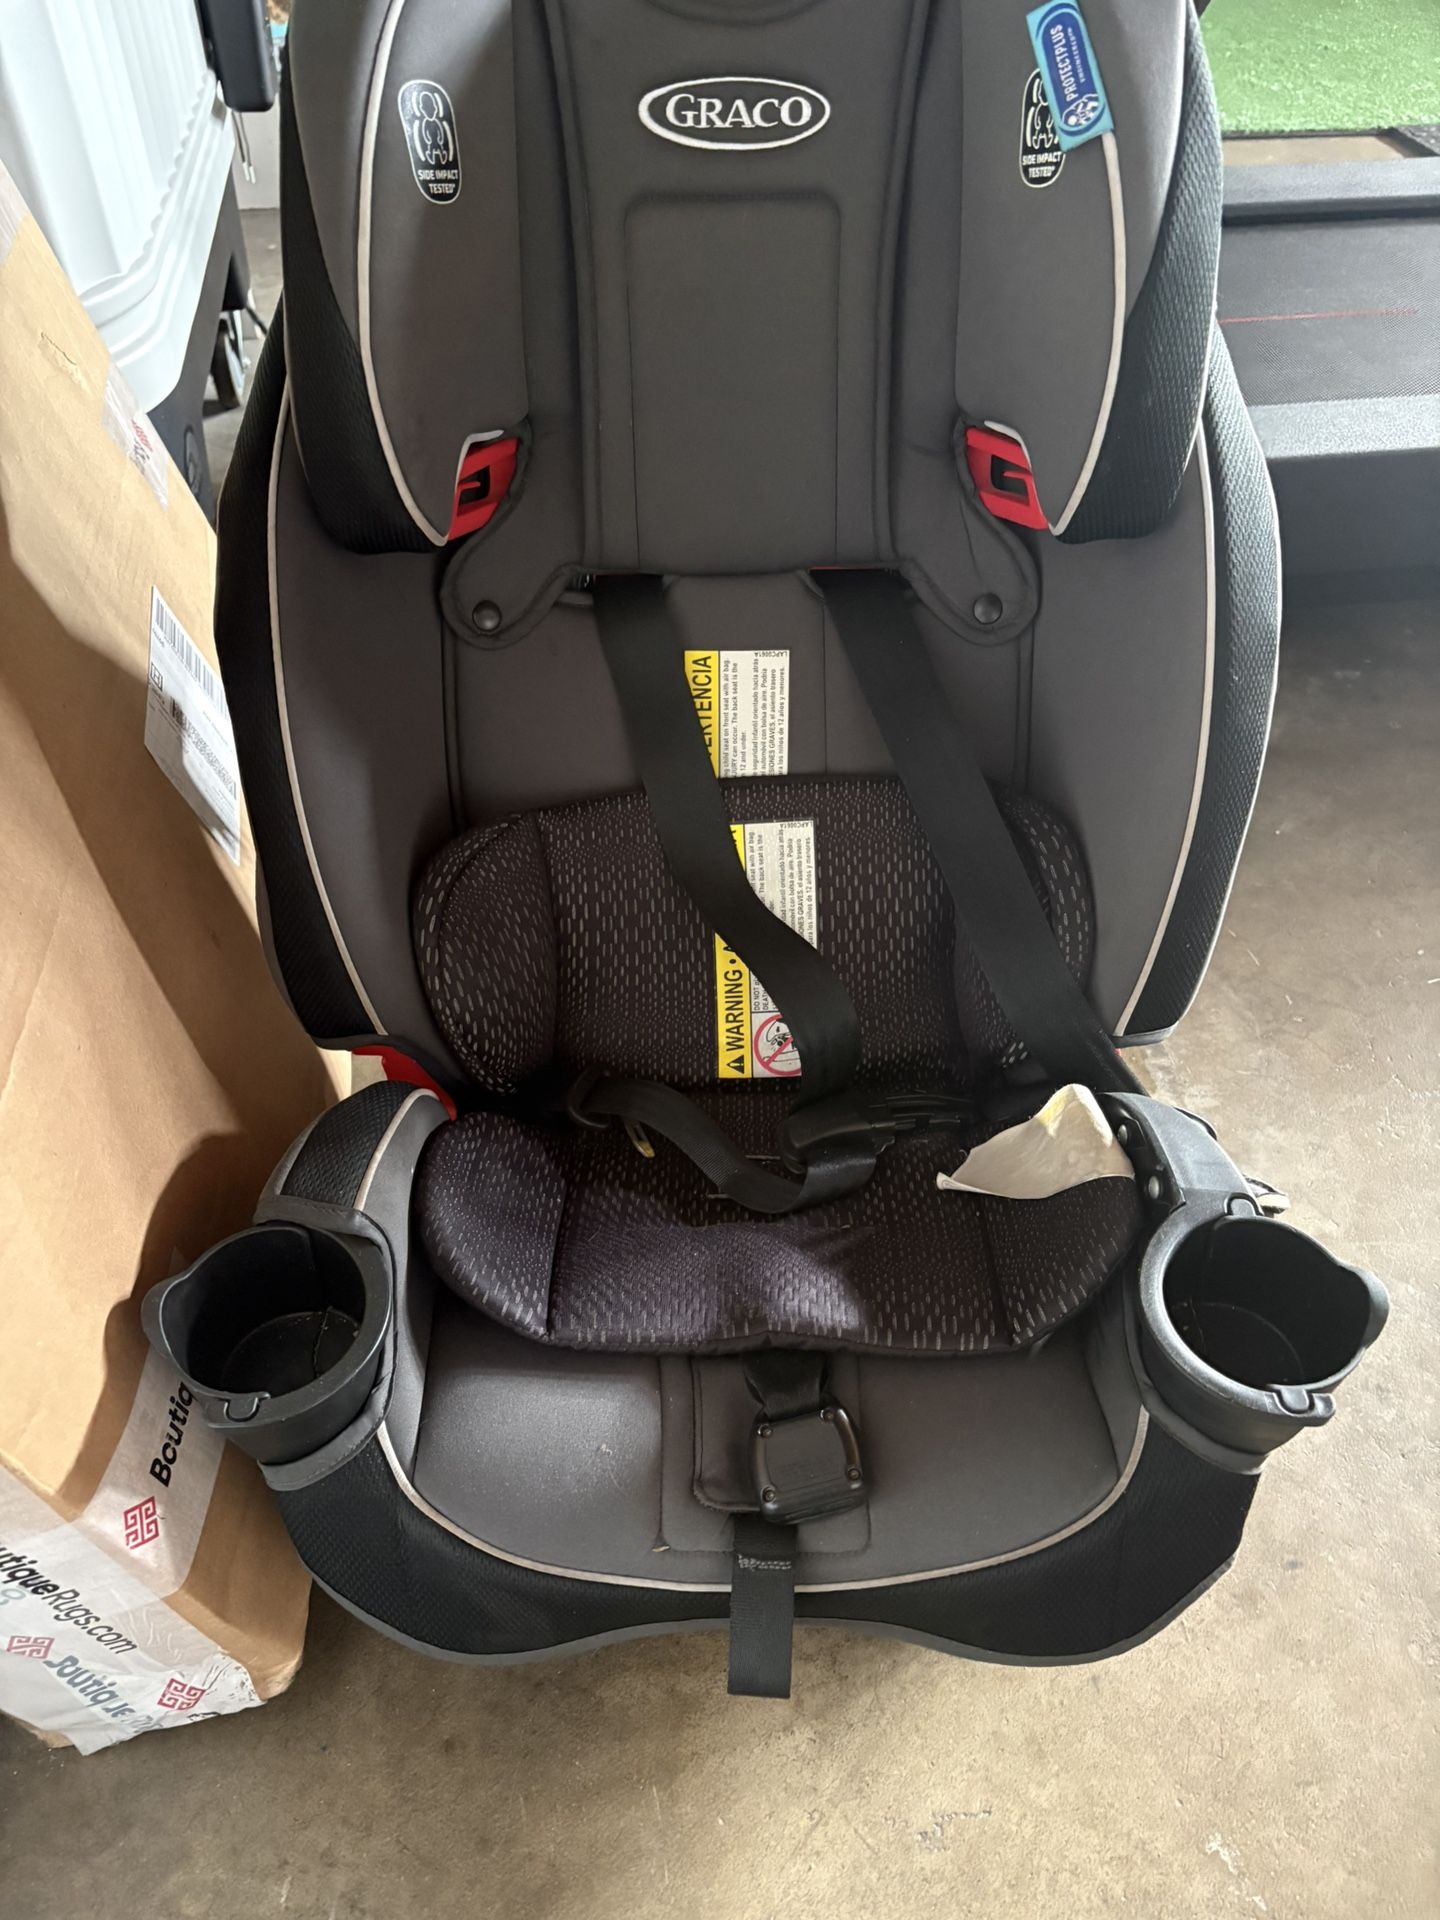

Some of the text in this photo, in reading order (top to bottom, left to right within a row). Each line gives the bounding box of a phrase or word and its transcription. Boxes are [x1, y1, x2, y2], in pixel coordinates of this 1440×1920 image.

[1050, 24, 1079, 102] PROTECTPLUS
[666, 94, 812, 128] GRACO
[1022, 151, 1062, 166] SIDE IMPACT
[418, 169, 459, 180] SIDE IMPACT
[723, 728, 730, 737] on
[778, 727, 784, 736] de
[724, 970, 745, 1052] WARNING
